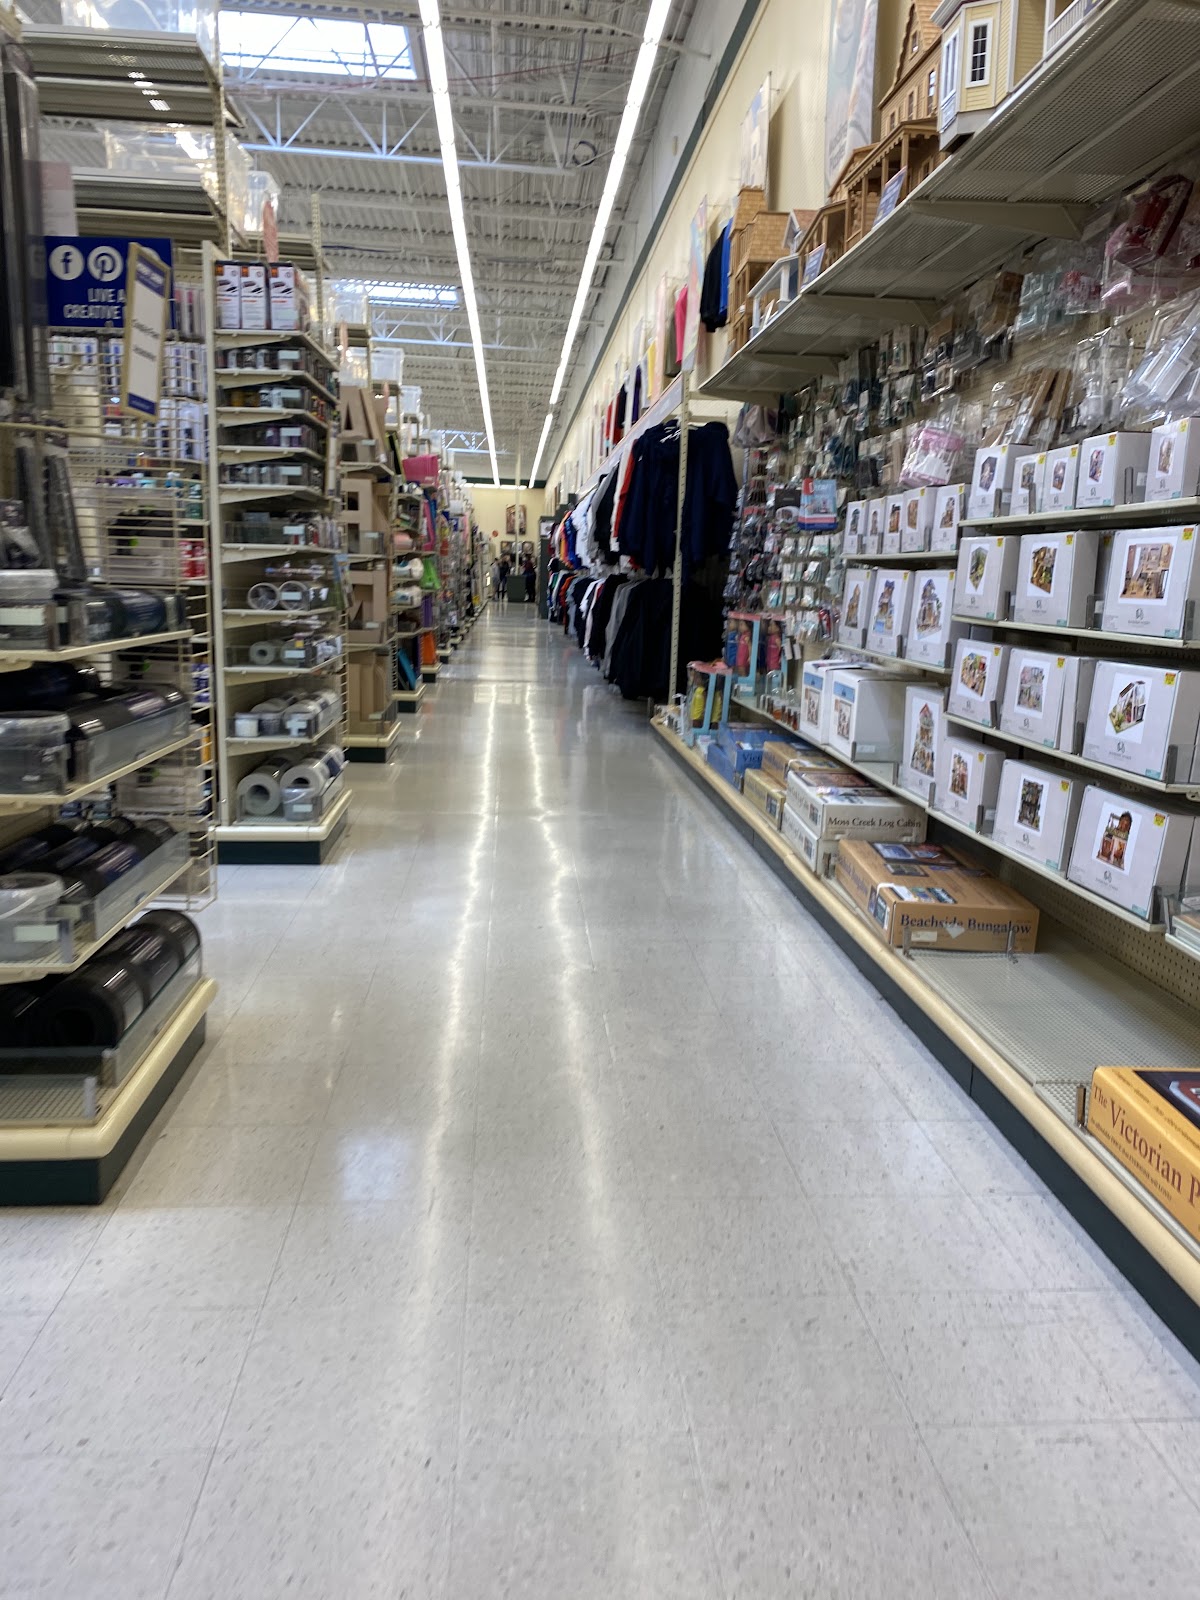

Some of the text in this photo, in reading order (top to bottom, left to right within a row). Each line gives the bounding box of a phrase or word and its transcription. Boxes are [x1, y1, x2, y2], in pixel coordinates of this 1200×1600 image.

[87, 288, 116, 303] LIVE
[63, 304, 121, 319] CREATIVE
[827, 816, 922, 829] Moss Creek Log Cabin
[900, 914, 1032, 935] Beachside Bungalow
[1093, 1084, 1108, 1109] The
[1110, 1098, 1183, 1195] Victorian
